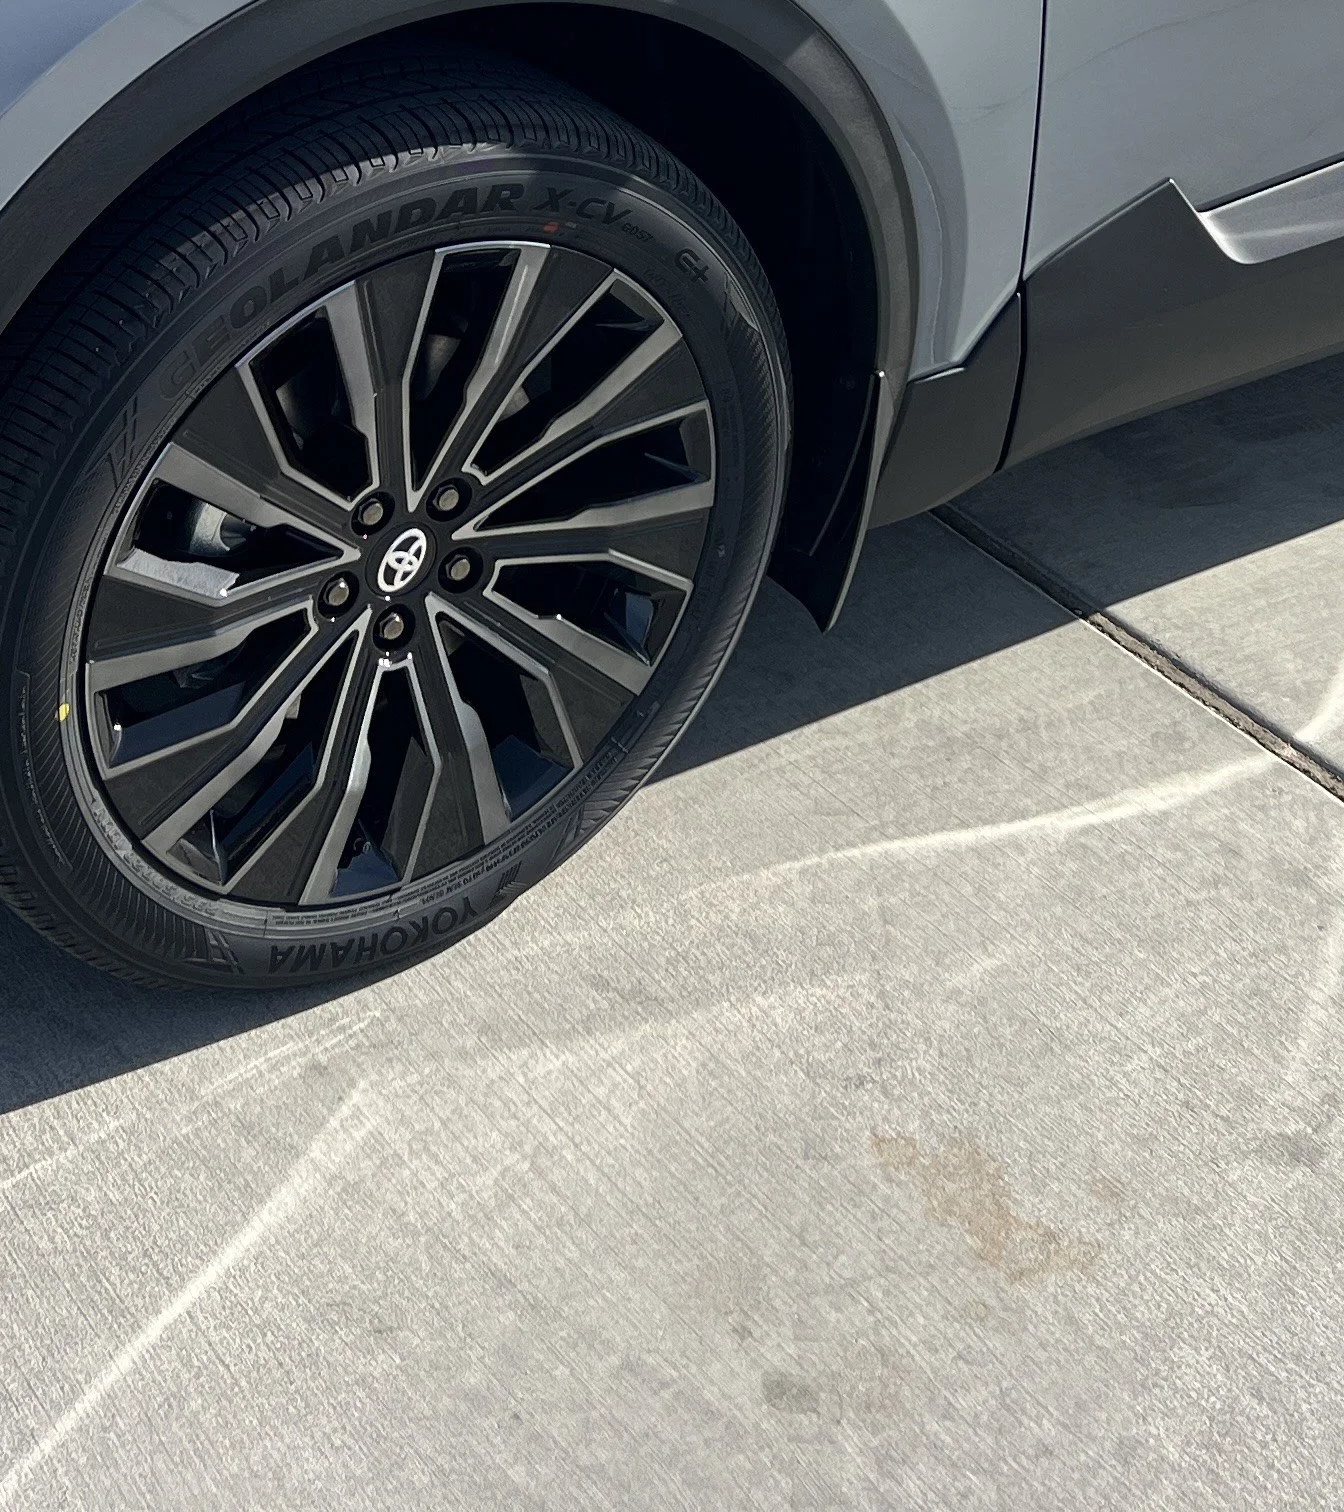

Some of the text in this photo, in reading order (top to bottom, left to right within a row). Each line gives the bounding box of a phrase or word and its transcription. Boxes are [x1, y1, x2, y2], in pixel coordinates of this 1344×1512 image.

[157, 182, 525, 400] GEOLANDAR
[532, 187, 633, 225] X-CV
[269, 896, 478, 973] YOKOHAMA
